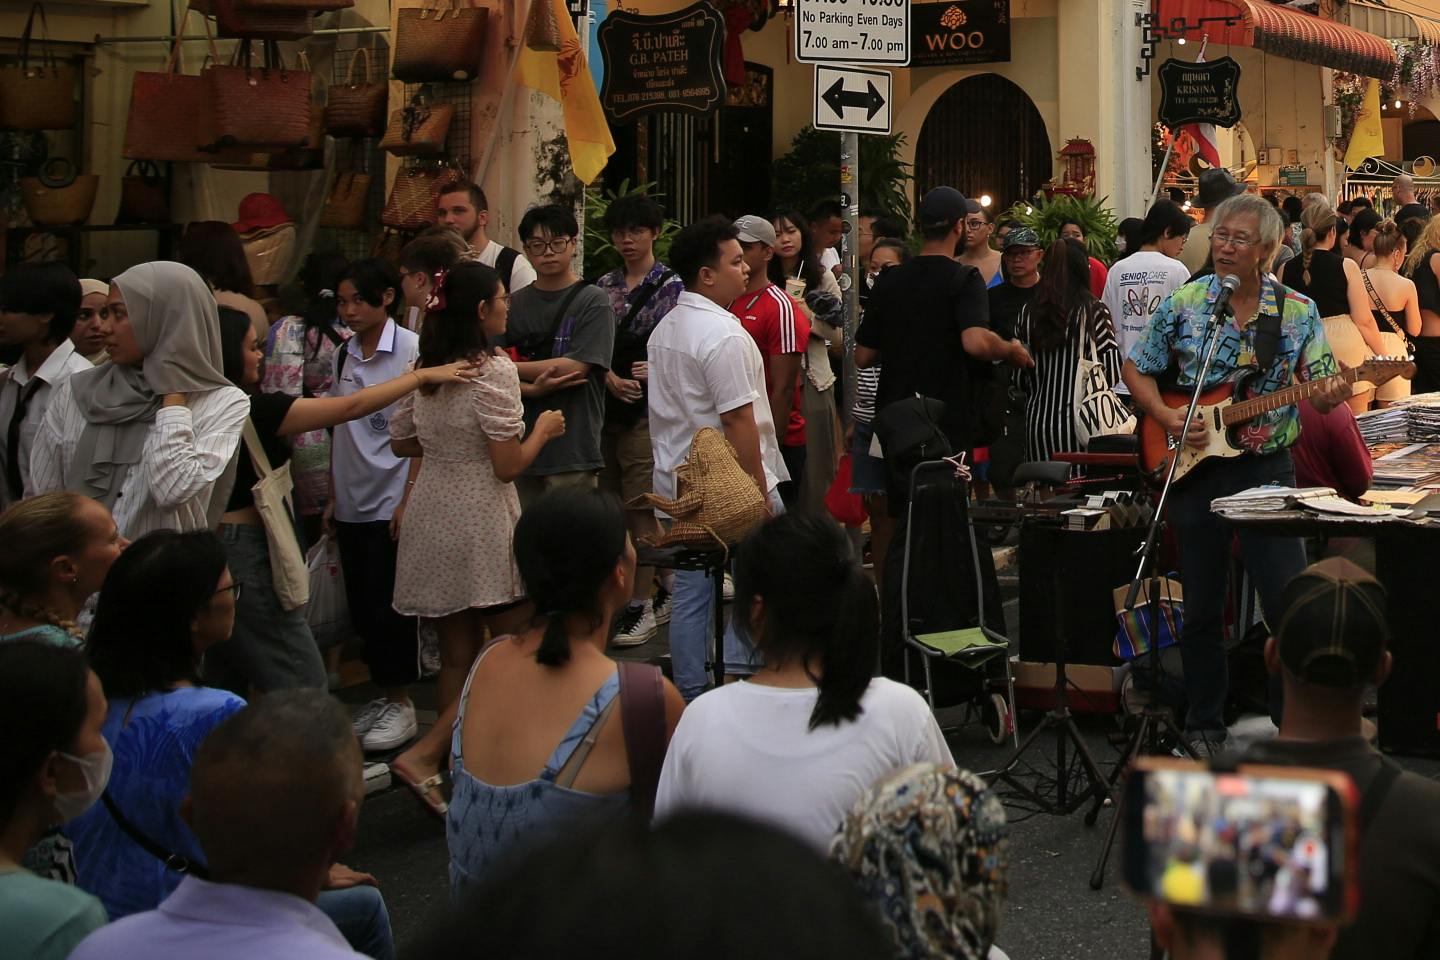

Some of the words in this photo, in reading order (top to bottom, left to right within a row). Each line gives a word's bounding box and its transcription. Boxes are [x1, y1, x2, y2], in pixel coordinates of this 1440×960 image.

[803, 11, 815, 23] No
[820, 11, 853, 27] Parking
[857, 13, 878, 25] Even
[882, 14, 903, 28] Days
[803, 30, 828, 48] 7.00
[887, 42, 904, 53] pm
[926, 31, 984, 50] WOO
[653, 49, 688, 63] PATEH
[1176, 85, 1216, 95] KRISHNA
